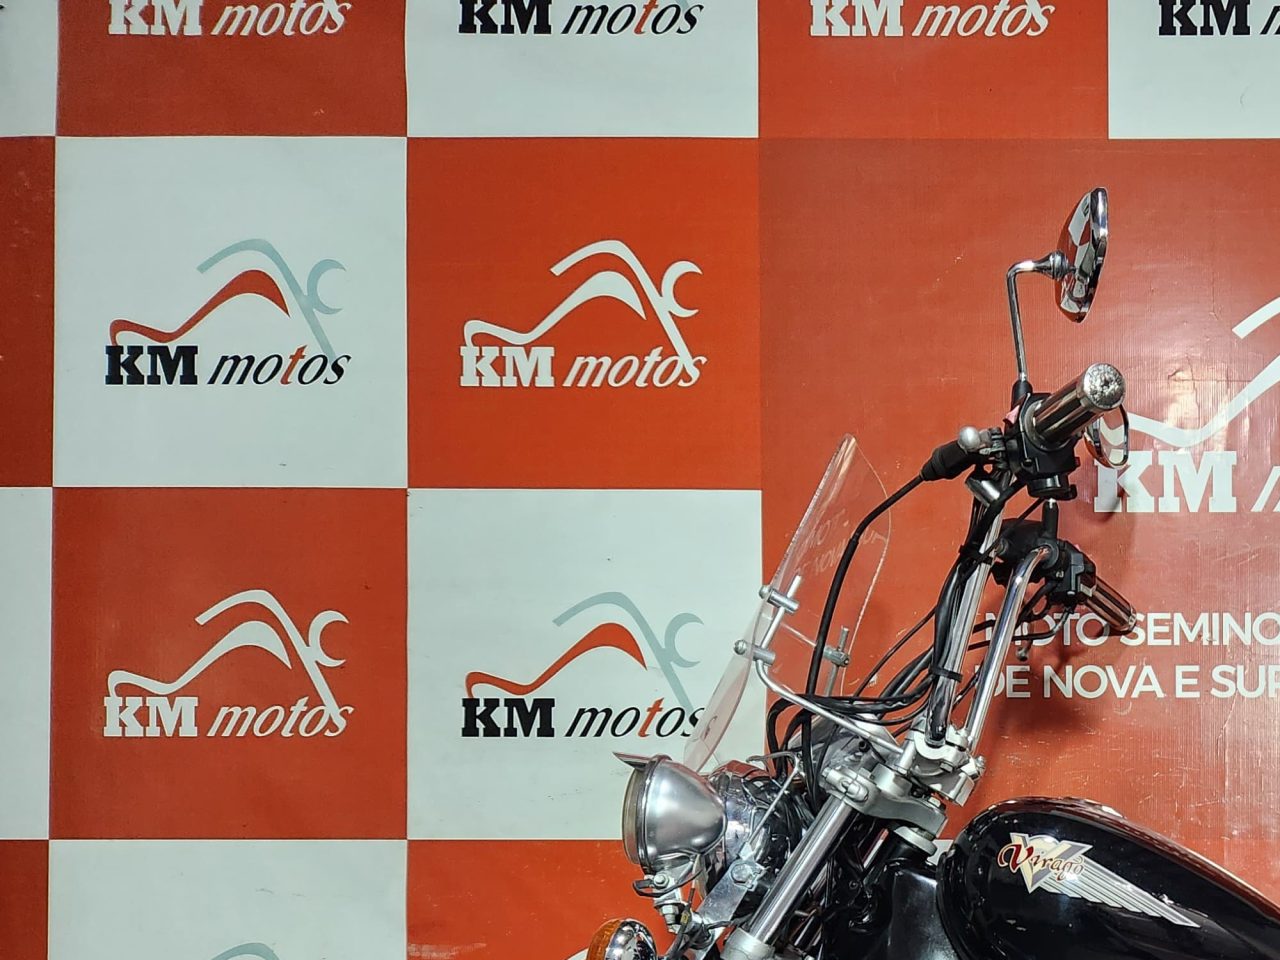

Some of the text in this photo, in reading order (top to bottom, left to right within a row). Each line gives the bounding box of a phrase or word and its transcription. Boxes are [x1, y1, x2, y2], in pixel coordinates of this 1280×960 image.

[109, 0, 351, 35] KM motos
[459, 0, 703, 34] KM motos
[810, 0, 1055, 36] KM motos
[1159, 0, 1250, 35] KM
[106, 346, 351, 385] KM motos
[461, 346, 707, 387] KM motos
[1094, 450, 1237, 513] KM
[1043, 664, 1164, 698] NOVA
[1175, 665, 1200, 698] E
[104, 696, 354, 737] KM motos
[462, 697, 555, 737] KM
